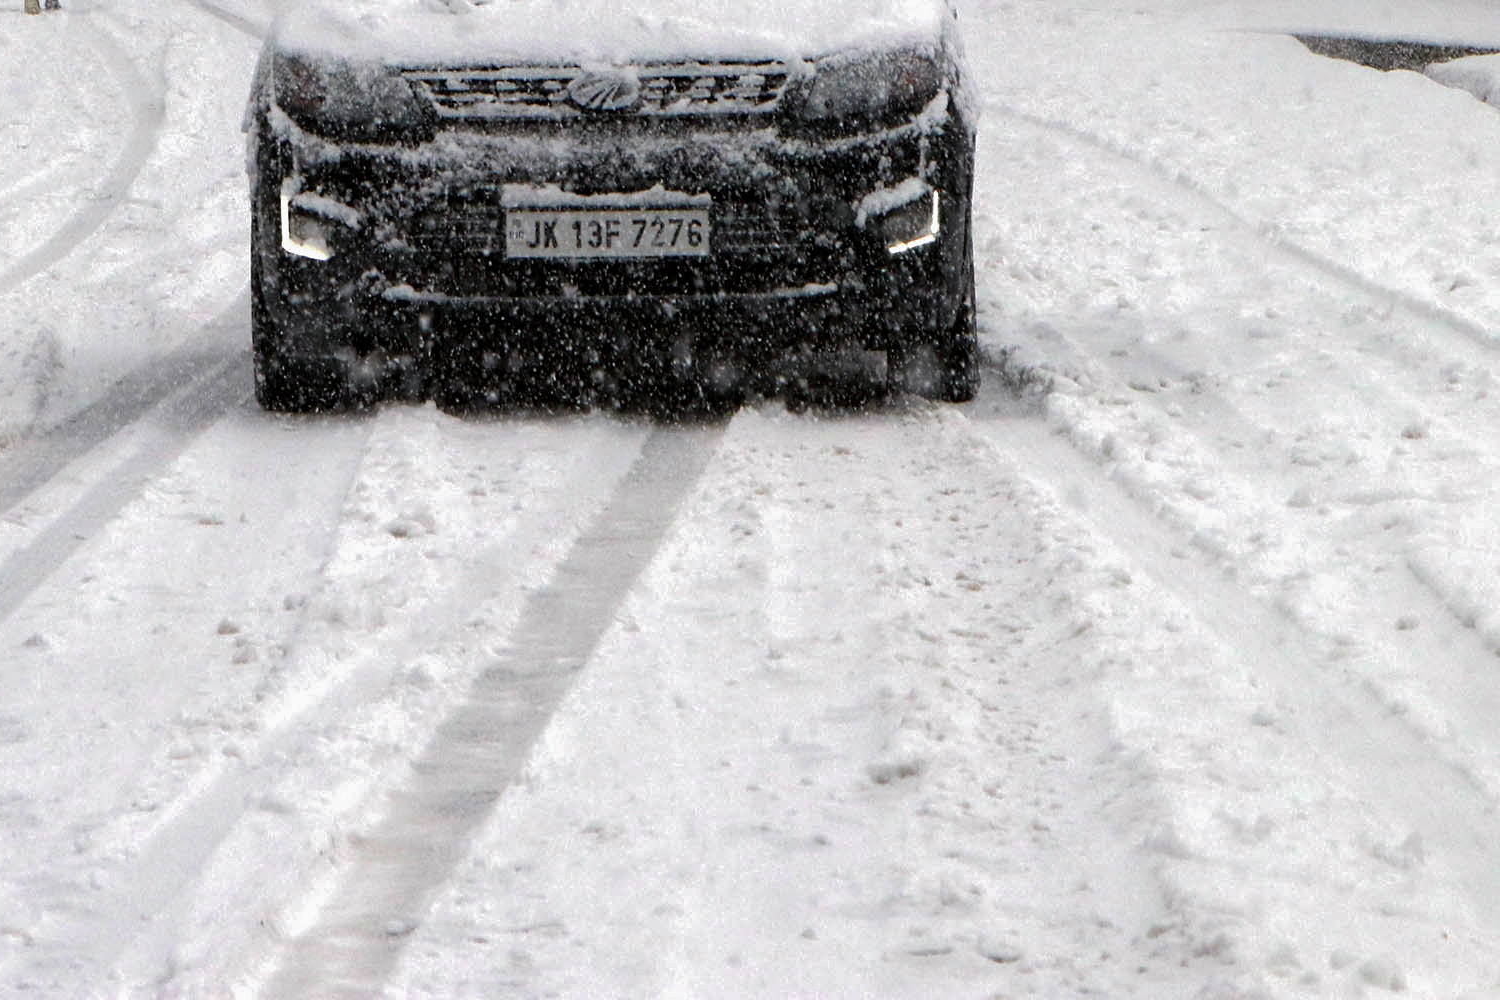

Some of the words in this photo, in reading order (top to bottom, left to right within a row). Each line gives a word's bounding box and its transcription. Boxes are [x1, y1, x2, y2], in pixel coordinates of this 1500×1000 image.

[526, 219, 558, 248] JK
[571, 219, 621, 248] 13F
[631, 216, 702, 248] 7276
